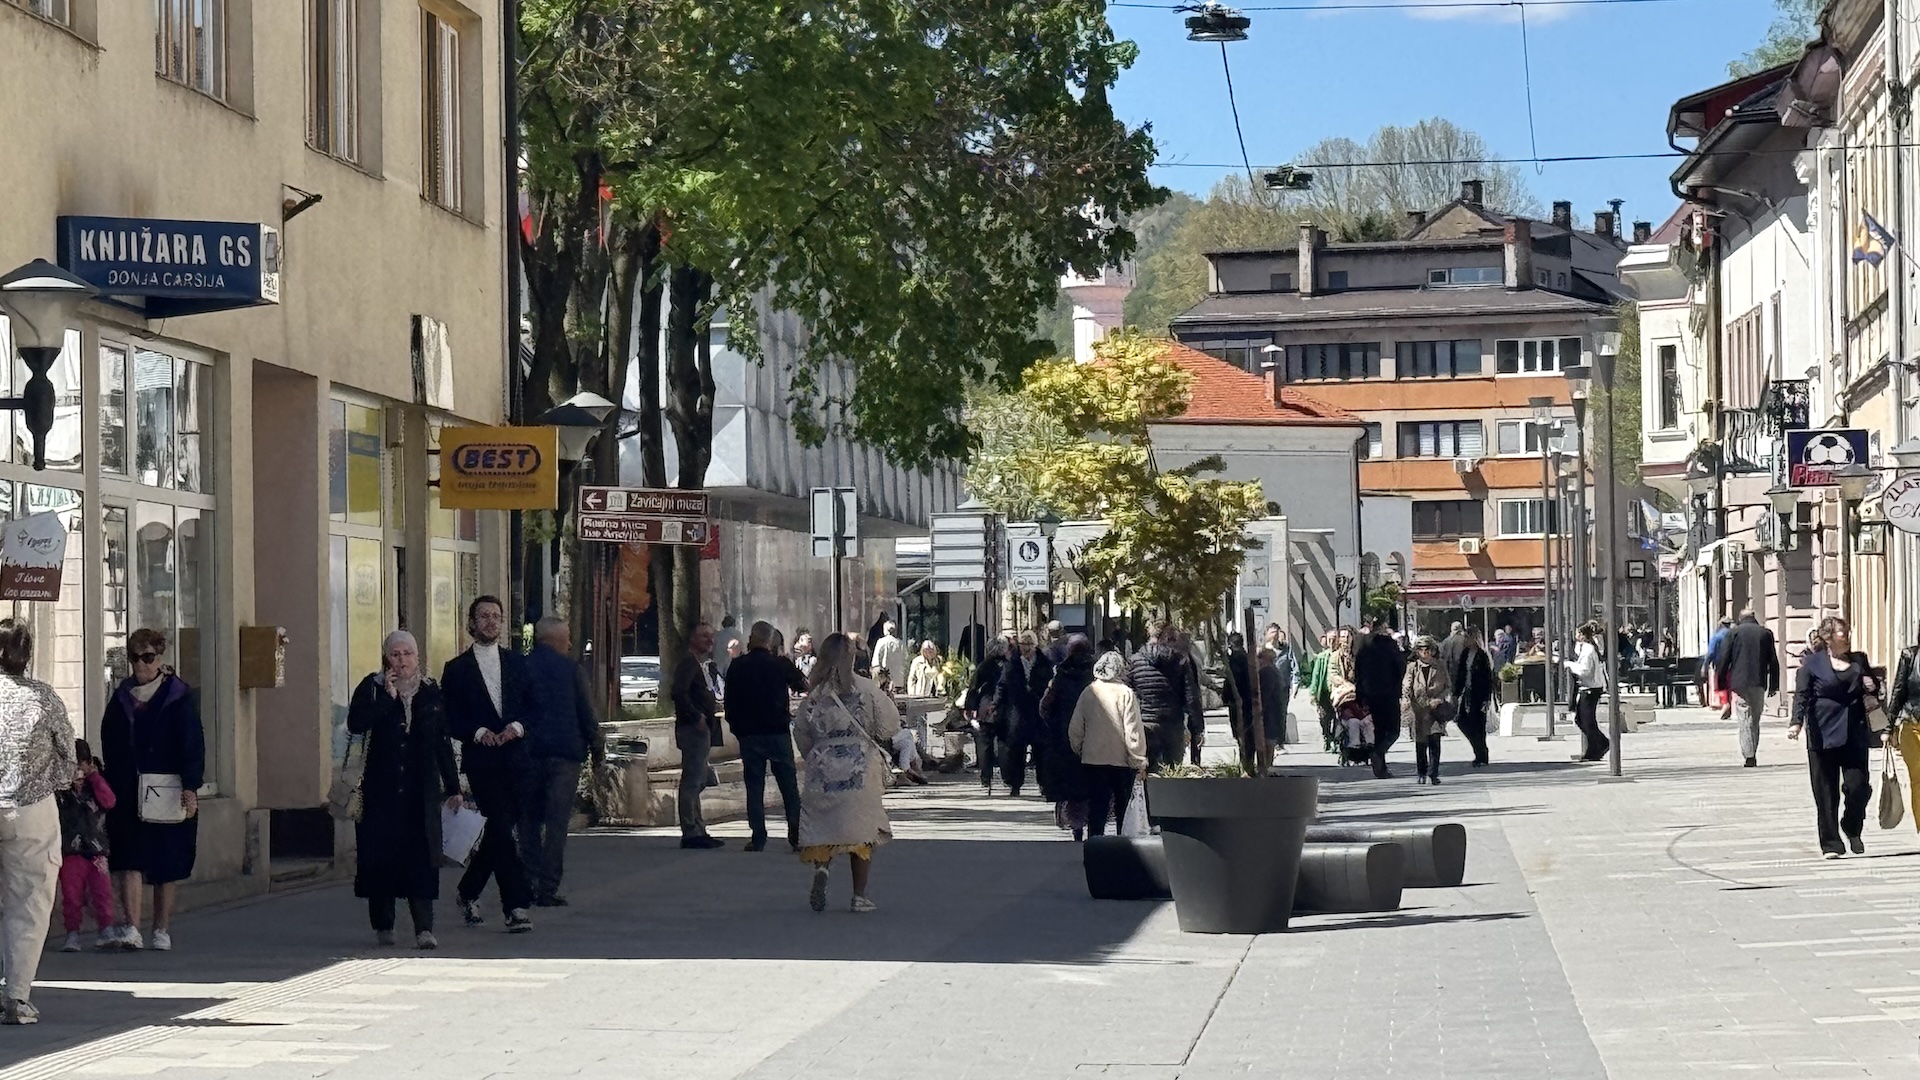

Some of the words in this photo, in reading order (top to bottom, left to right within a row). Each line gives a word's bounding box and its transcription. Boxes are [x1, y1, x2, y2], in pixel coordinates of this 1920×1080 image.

[80, 226, 208, 266] KNJIŽARA
[219, 235, 251, 267] GS
[108, 270, 159, 286] DONJA
[463, 449, 531, 469] BEST
